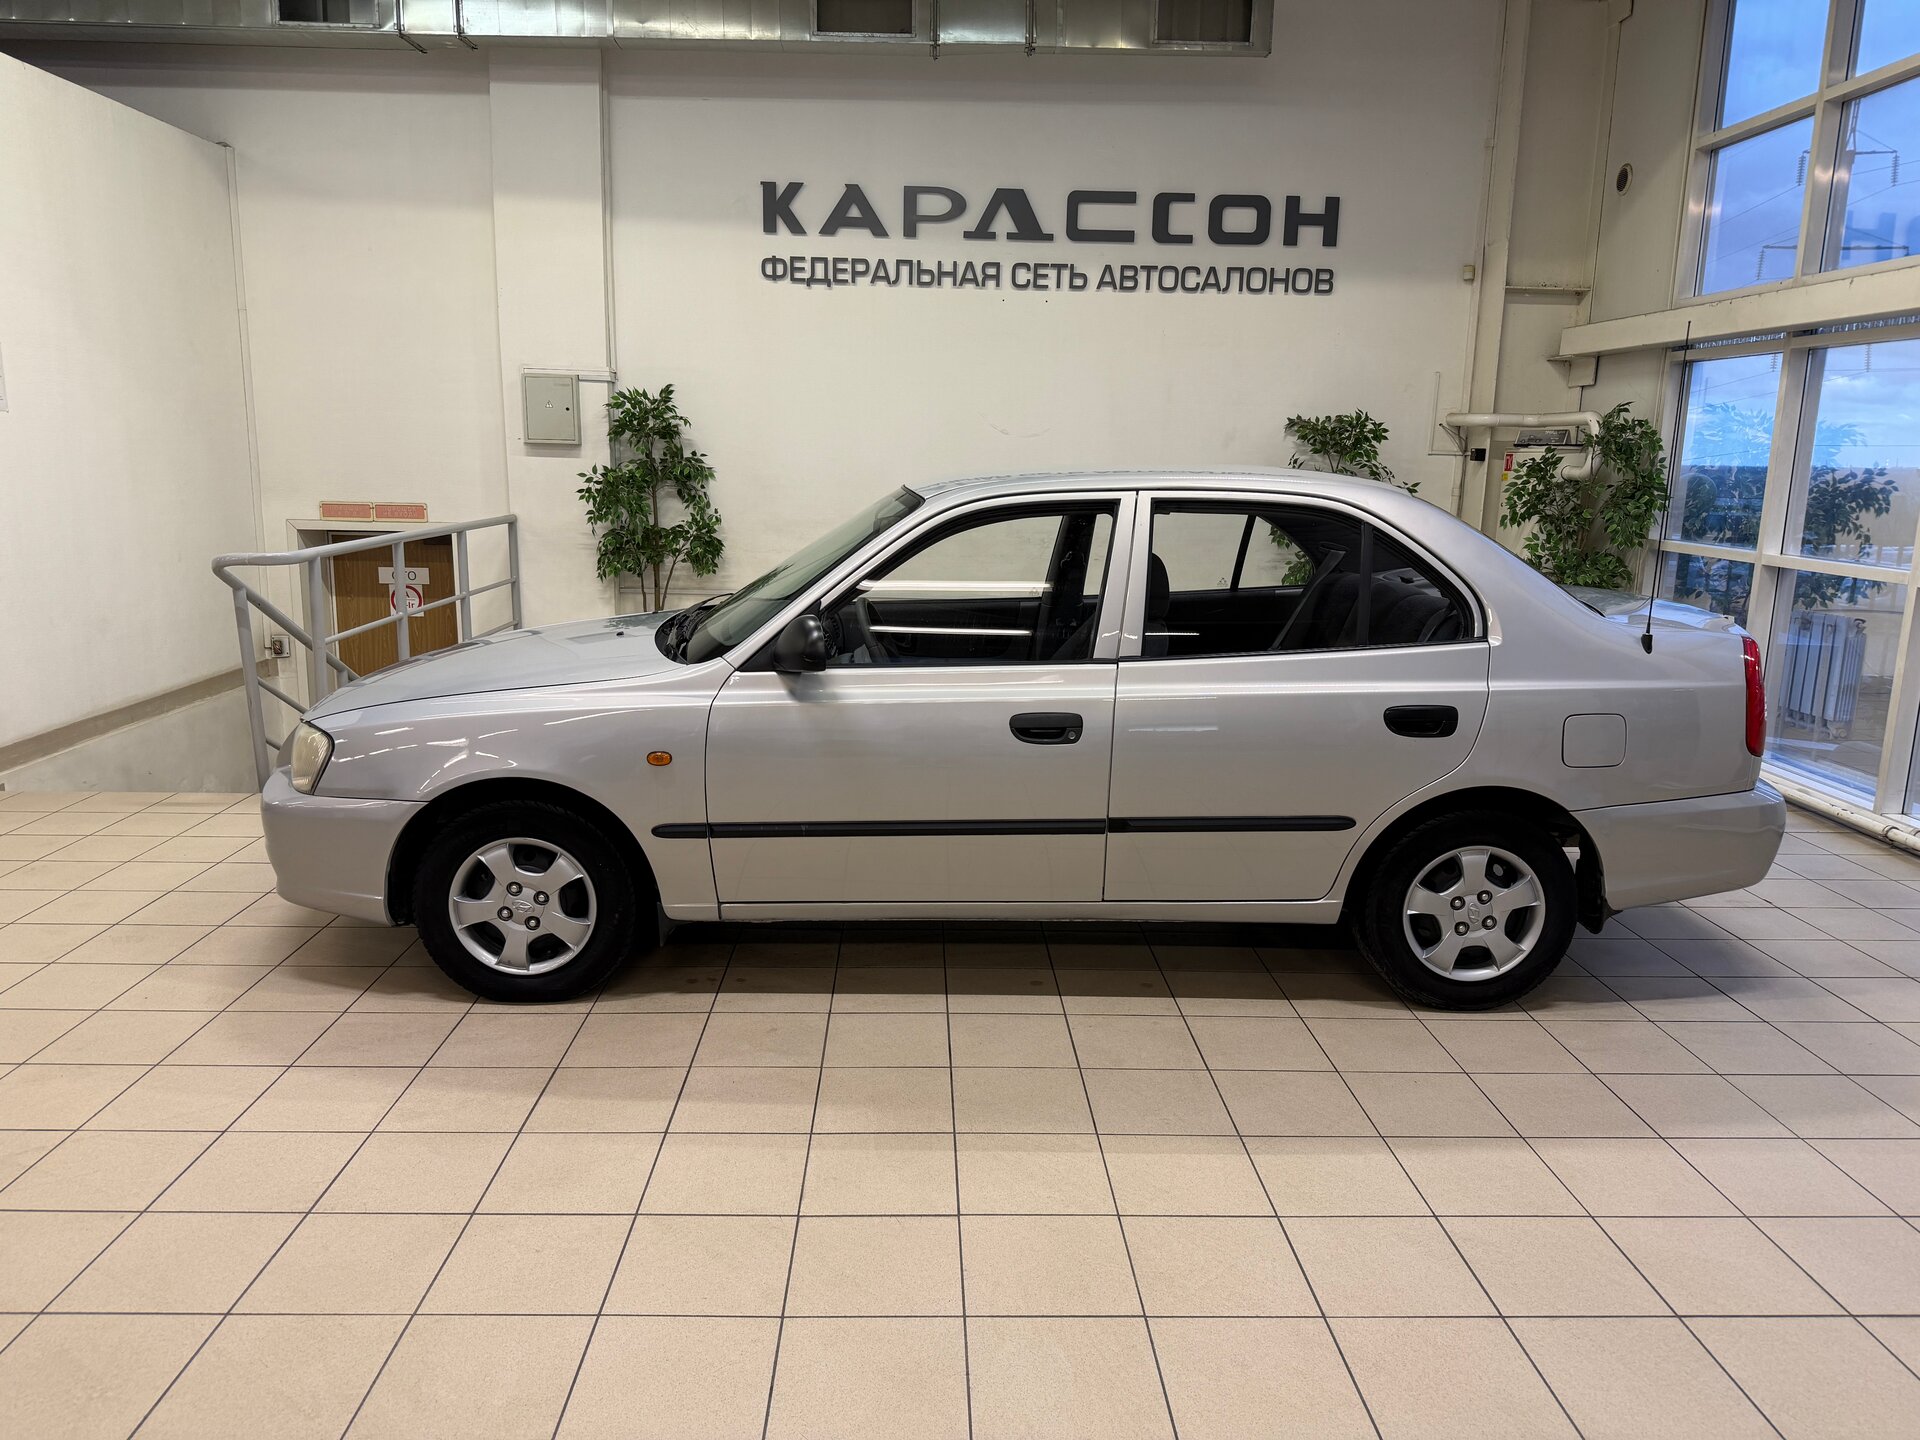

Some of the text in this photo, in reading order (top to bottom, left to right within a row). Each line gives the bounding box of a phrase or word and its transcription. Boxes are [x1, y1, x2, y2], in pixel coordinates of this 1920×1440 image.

[761, 255, 1335, 294] ФЕДЕРАЛЬНАЯ СЕТЬ АВТОСАЛОНОВ
